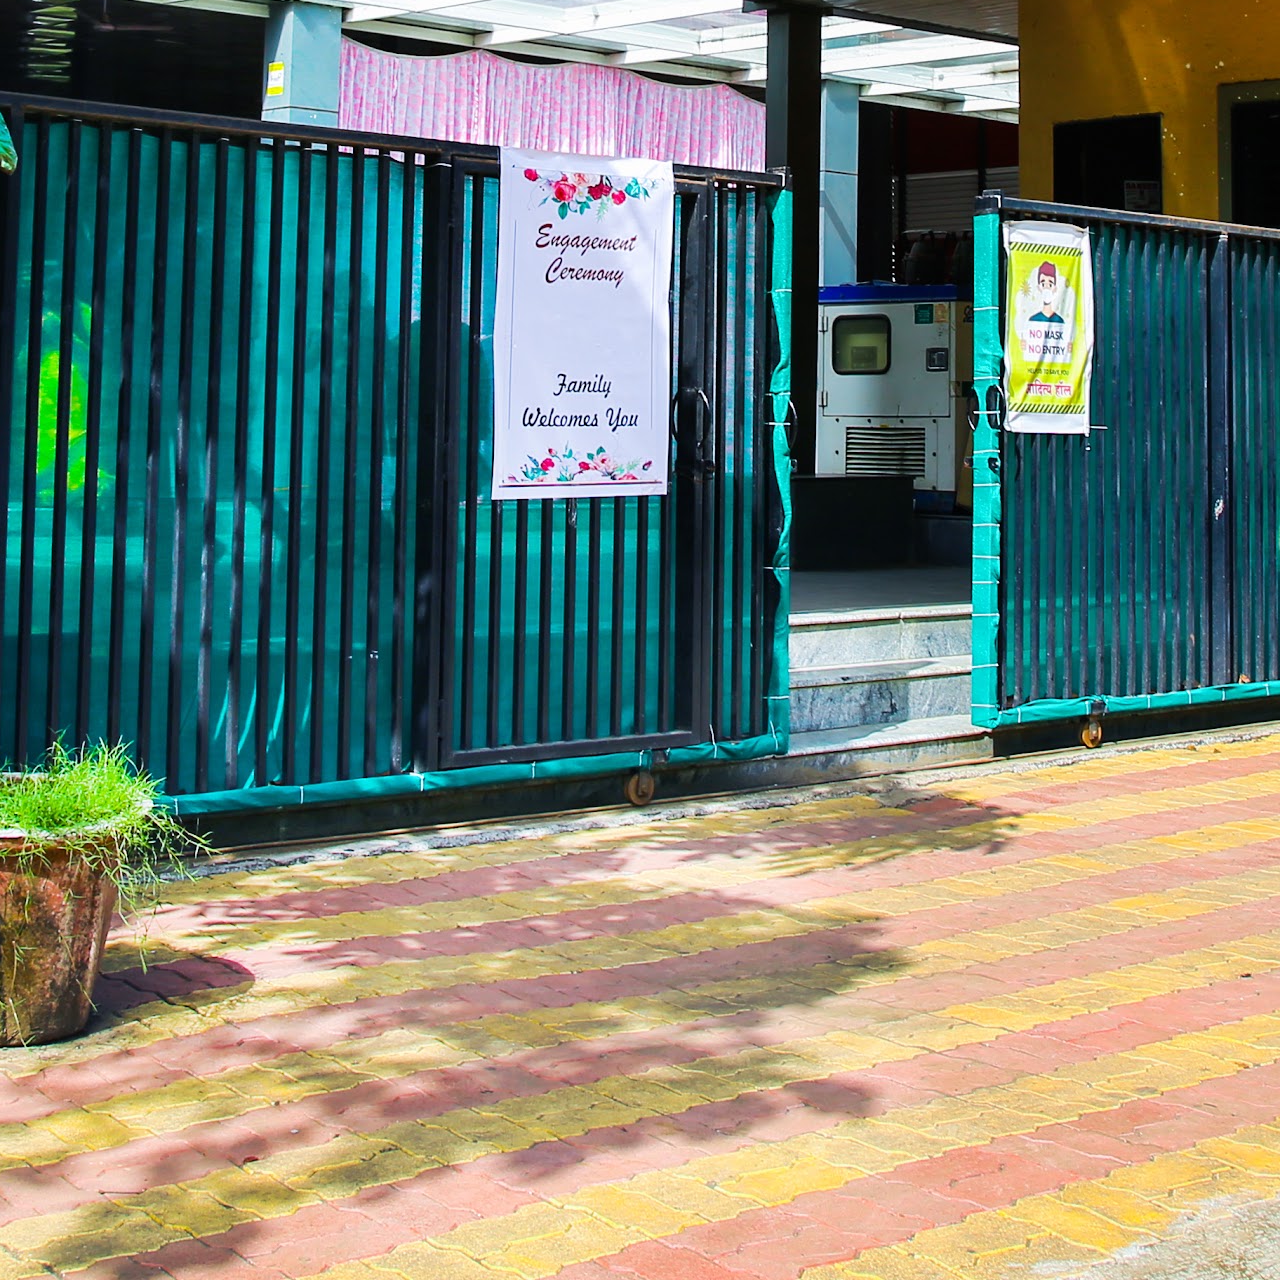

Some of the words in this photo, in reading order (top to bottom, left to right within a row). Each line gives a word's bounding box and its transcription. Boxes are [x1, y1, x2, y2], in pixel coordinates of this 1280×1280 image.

[535, 223, 638, 255] Engagement
[545, 257, 625, 288] Ceremony
[1029, 329, 1042, 339] NO
[1044, 330, 1064, 340] MASK
[1028, 344, 1041, 354] NO
[1042, 345, 1065, 355] ENTRY
[553, 373, 612, 398] Family
[522, 407, 598, 428] Welcomes
[605, 407, 639, 432] You
